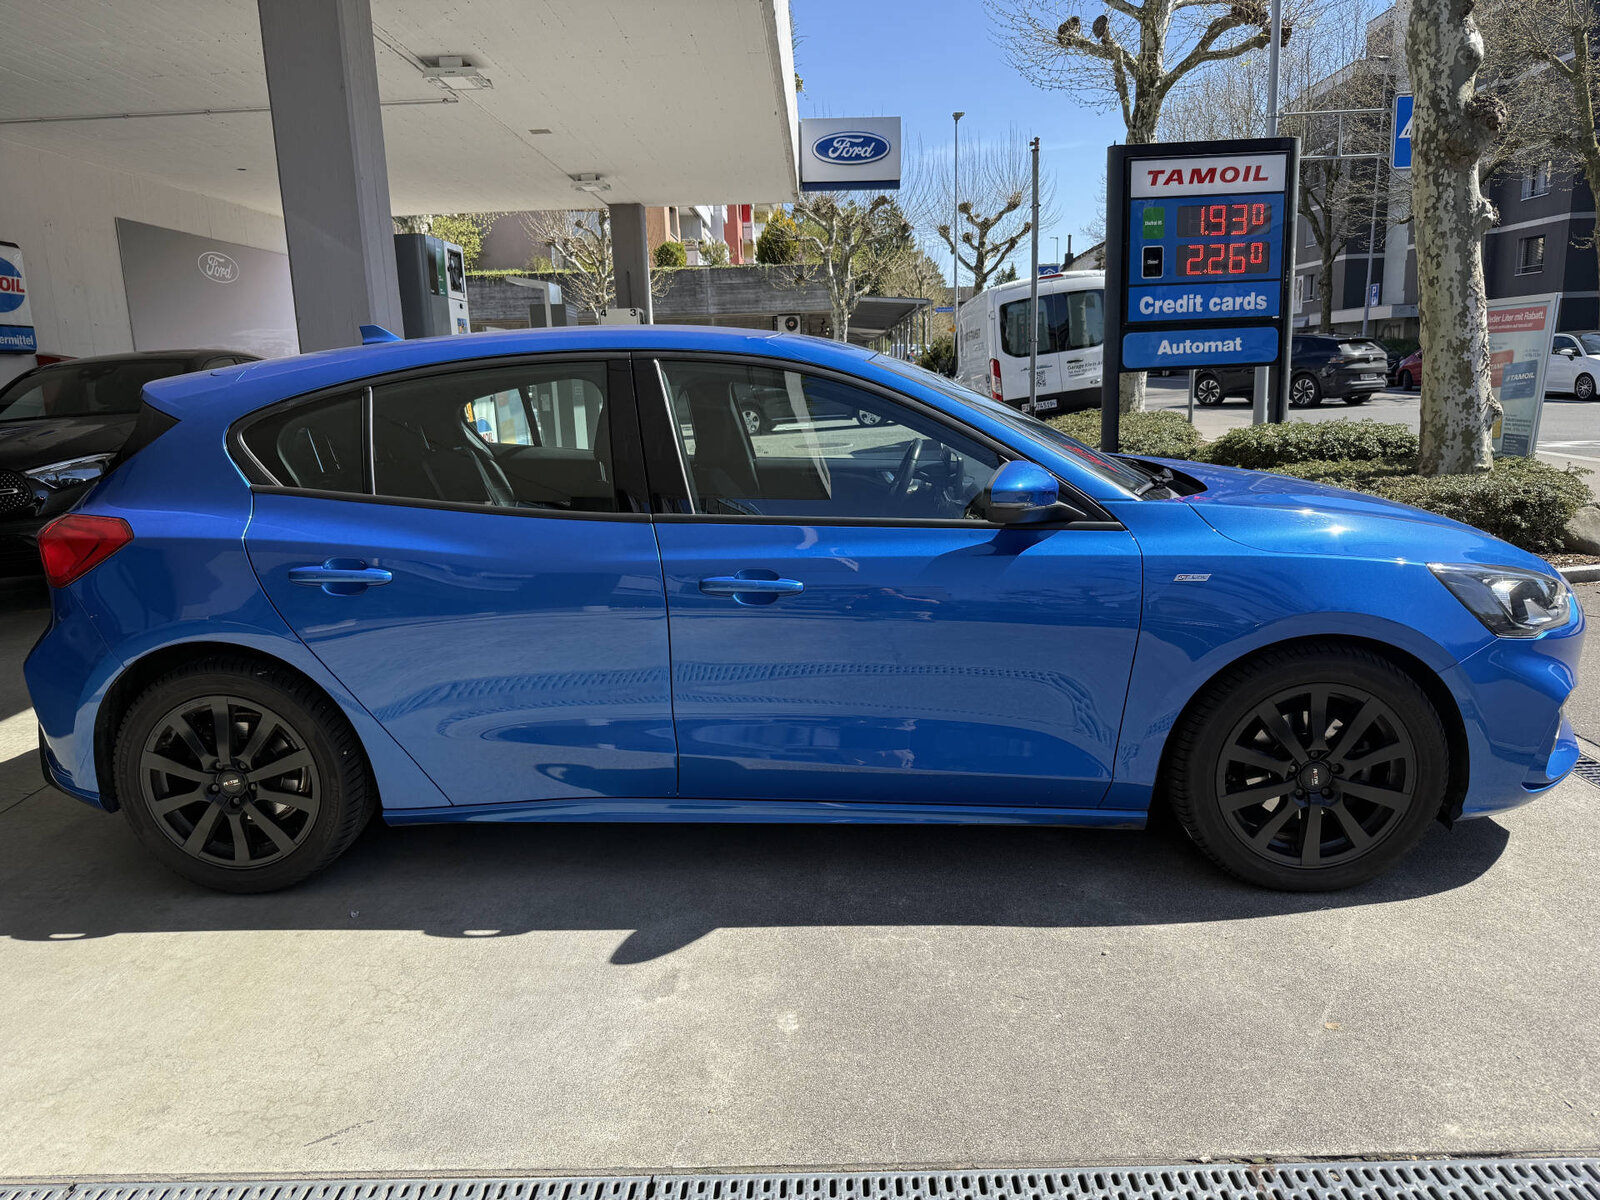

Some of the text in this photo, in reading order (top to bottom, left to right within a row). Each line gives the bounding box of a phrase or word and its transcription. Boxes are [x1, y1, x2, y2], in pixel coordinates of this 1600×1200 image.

[828, 137, 876, 158] Ford
[1147, 165, 1269, 187] TAMOIL
[206, 254, 233, 279] Ford
[1139, 291, 1268, 315] Credit cards
[600, 309, 607, 317] 4
[630, 309, 637, 317] 3
[1157, 337, 1242, 355] Automat
[1510, 372, 1535, 380] TAMOIL
